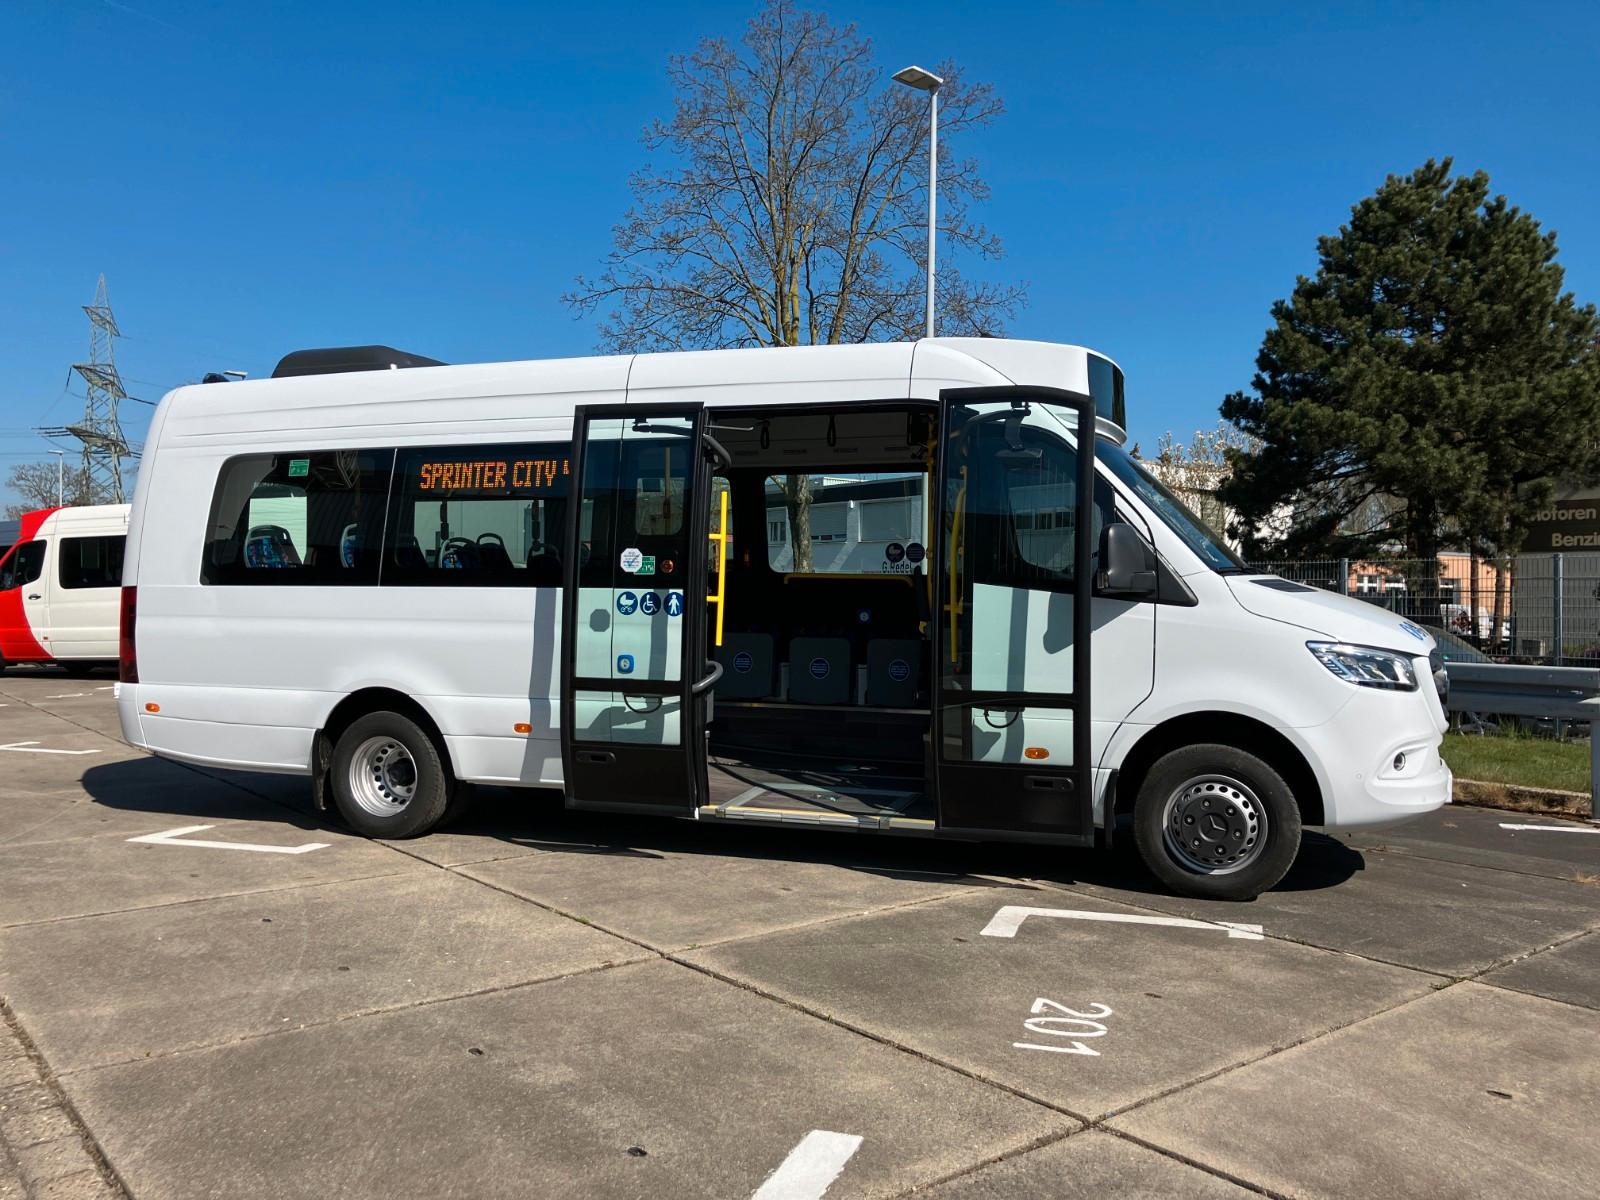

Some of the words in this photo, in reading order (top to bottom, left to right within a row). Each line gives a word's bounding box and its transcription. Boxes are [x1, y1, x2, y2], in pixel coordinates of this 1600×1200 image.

[420, 461, 507, 489] SPRINTER
[512, 460, 557, 488] CITY
[1012, 997, 1113, 1057] 201
